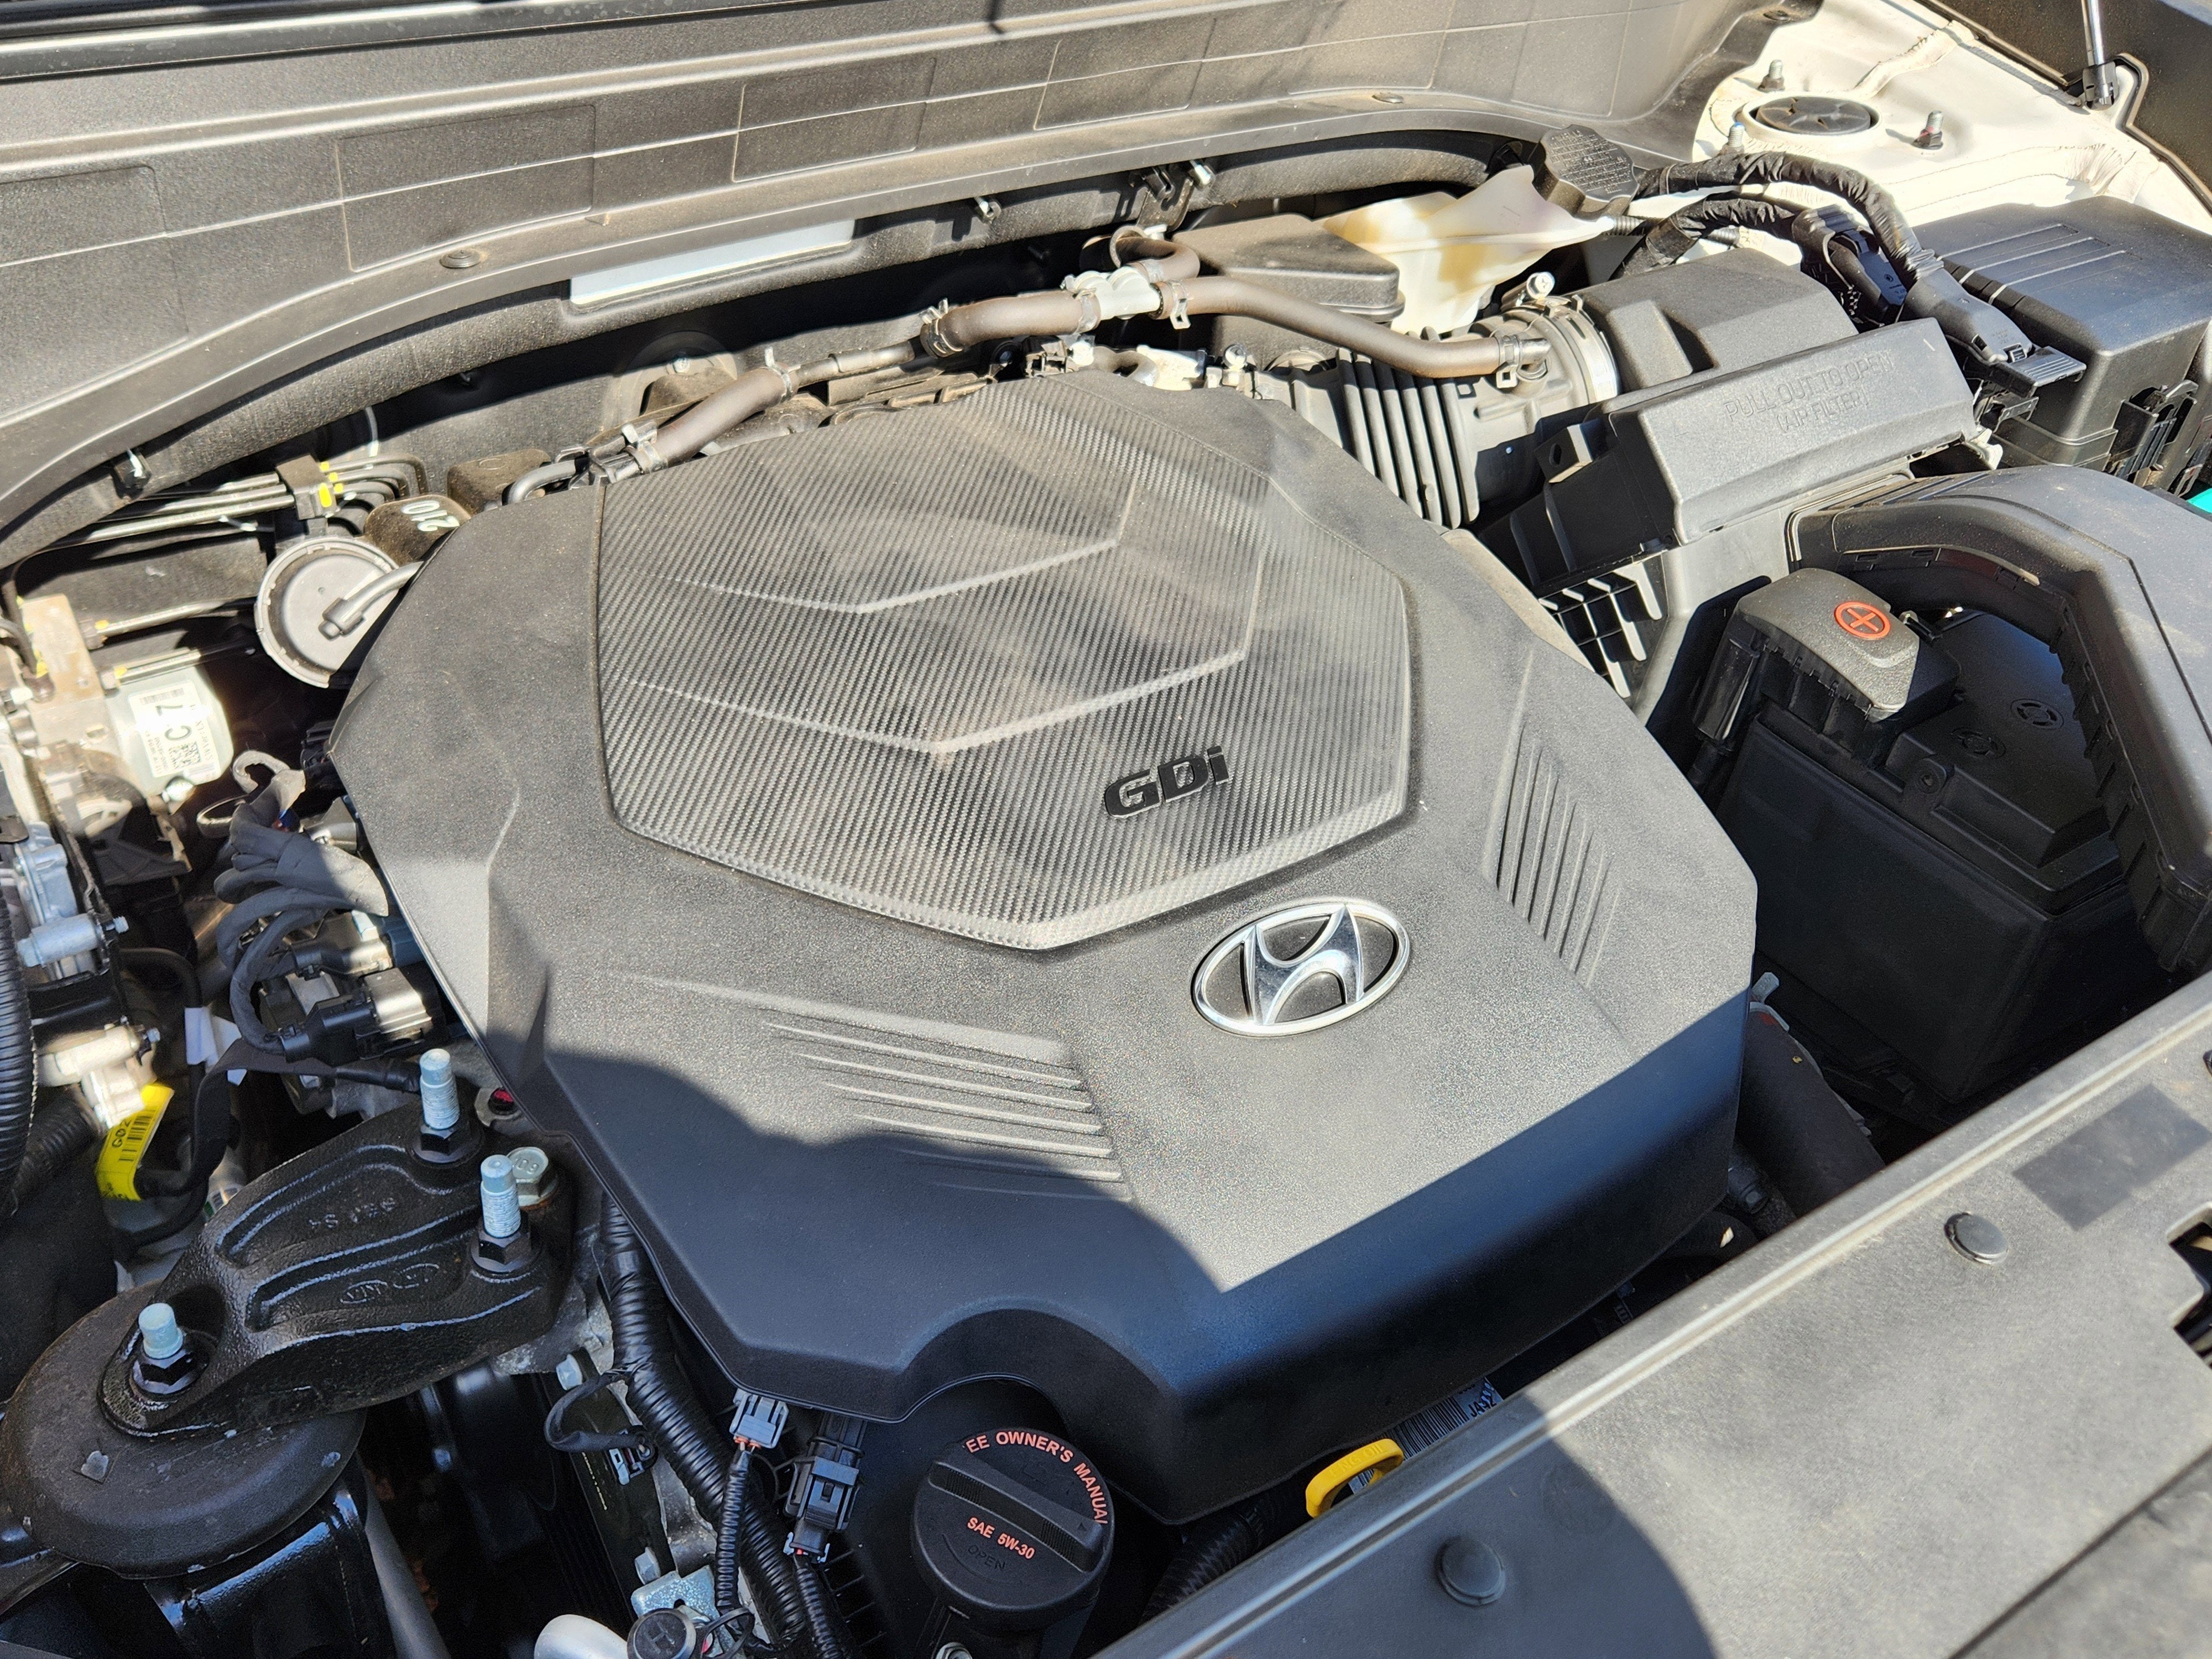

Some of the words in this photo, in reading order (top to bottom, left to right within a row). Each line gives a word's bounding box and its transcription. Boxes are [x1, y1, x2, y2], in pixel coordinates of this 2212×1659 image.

[1723, 390, 1776, 422] PULL
[1777, 376, 1813, 405] OUT
[1815, 367, 1844, 391] TO
[1845, 349, 1895, 382] OPEN
[1104, 745, 1230, 818] GDi
[962, 1434, 990, 1453] EE
[995, 1431, 1074, 1463] OWNER'S
[1328, 1455, 1362, 1478] ENG
[1363, 1443, 1387, 1458] OIL
[967, 1516, 995, 1538] SAE
[997, 1533, 1035, 1559] 5W-30
[968, 1545, 1006, 1571] OPEN
